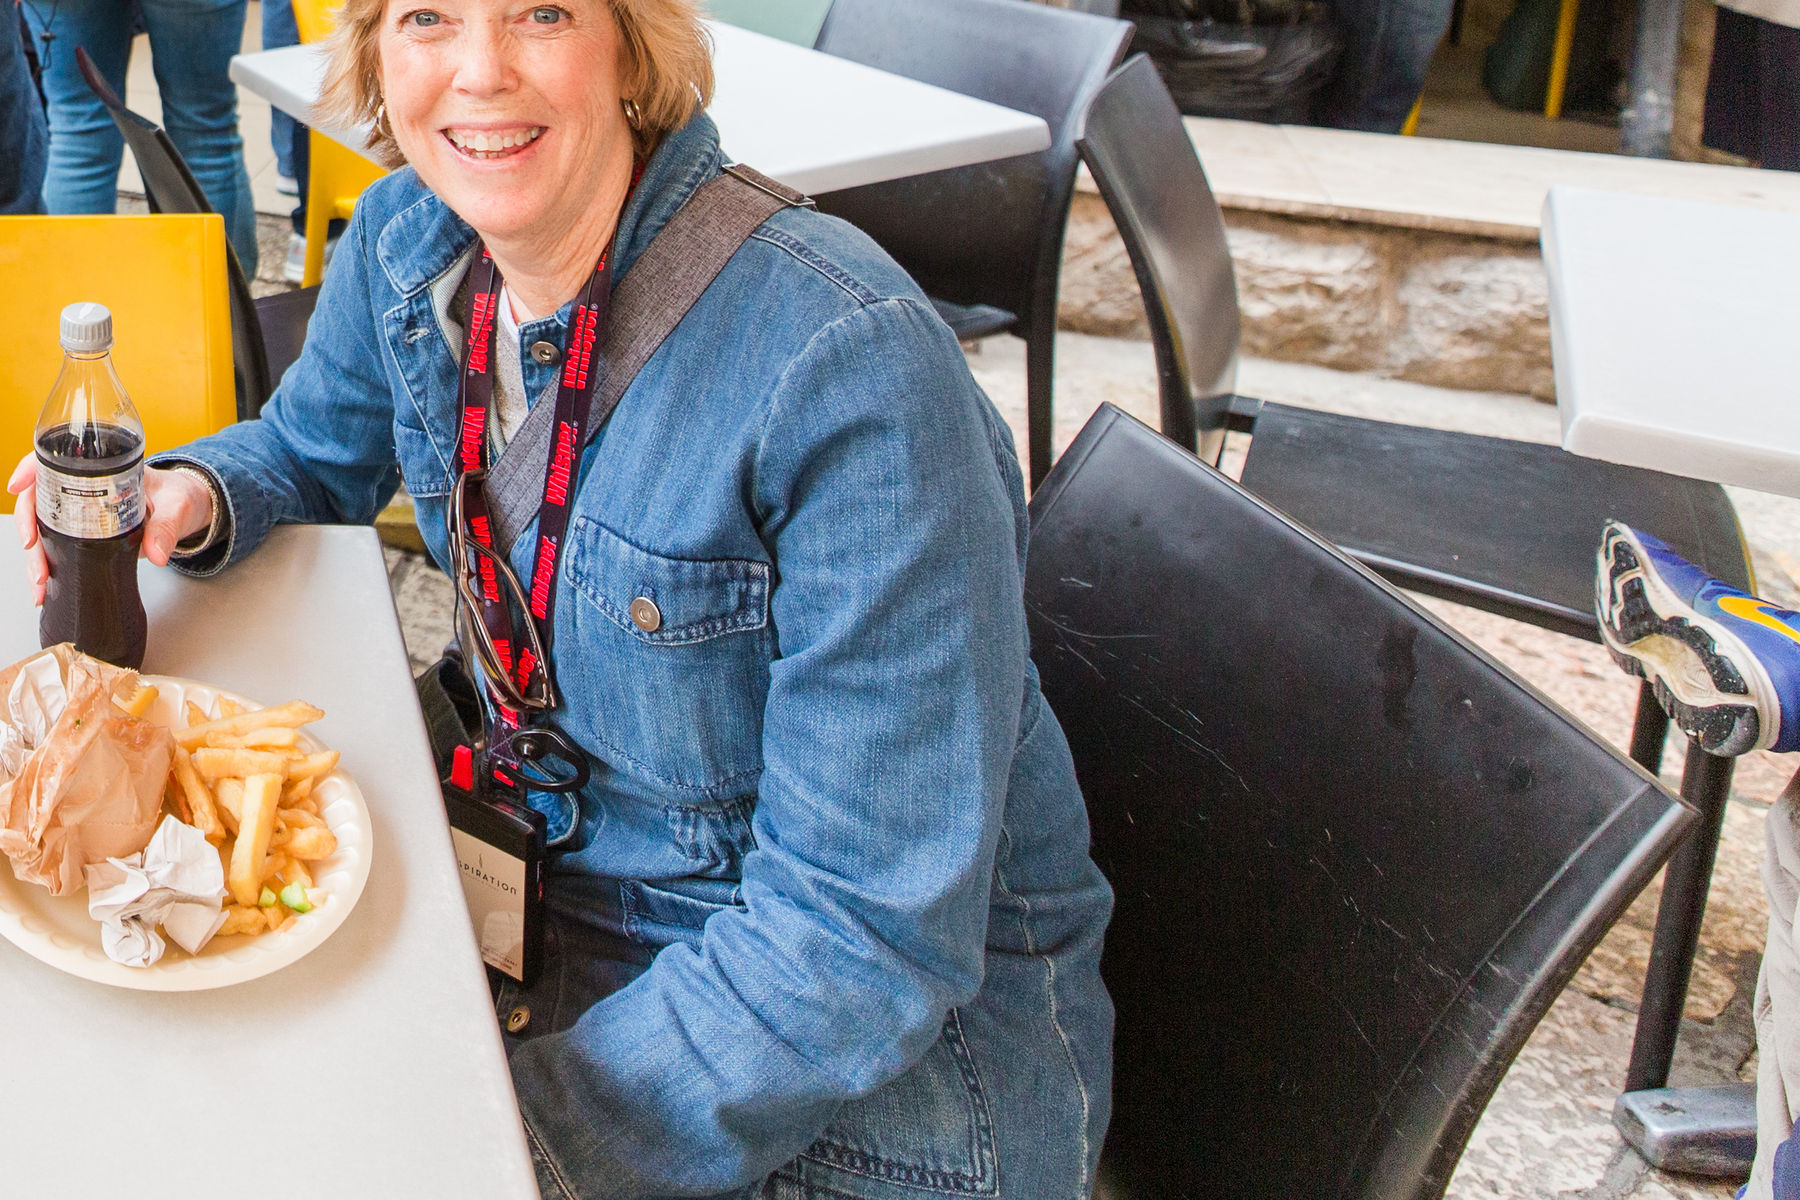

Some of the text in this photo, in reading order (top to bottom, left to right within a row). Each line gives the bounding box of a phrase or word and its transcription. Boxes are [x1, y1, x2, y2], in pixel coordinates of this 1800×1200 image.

[468, 292, 497, 375] Whisper
[563, 304, 598, 390] Whisper
[545, 421, 578, 506] Whisper
[470, 515, 500, 603] Whsper
[531, 536, 558, 620] Whisper
